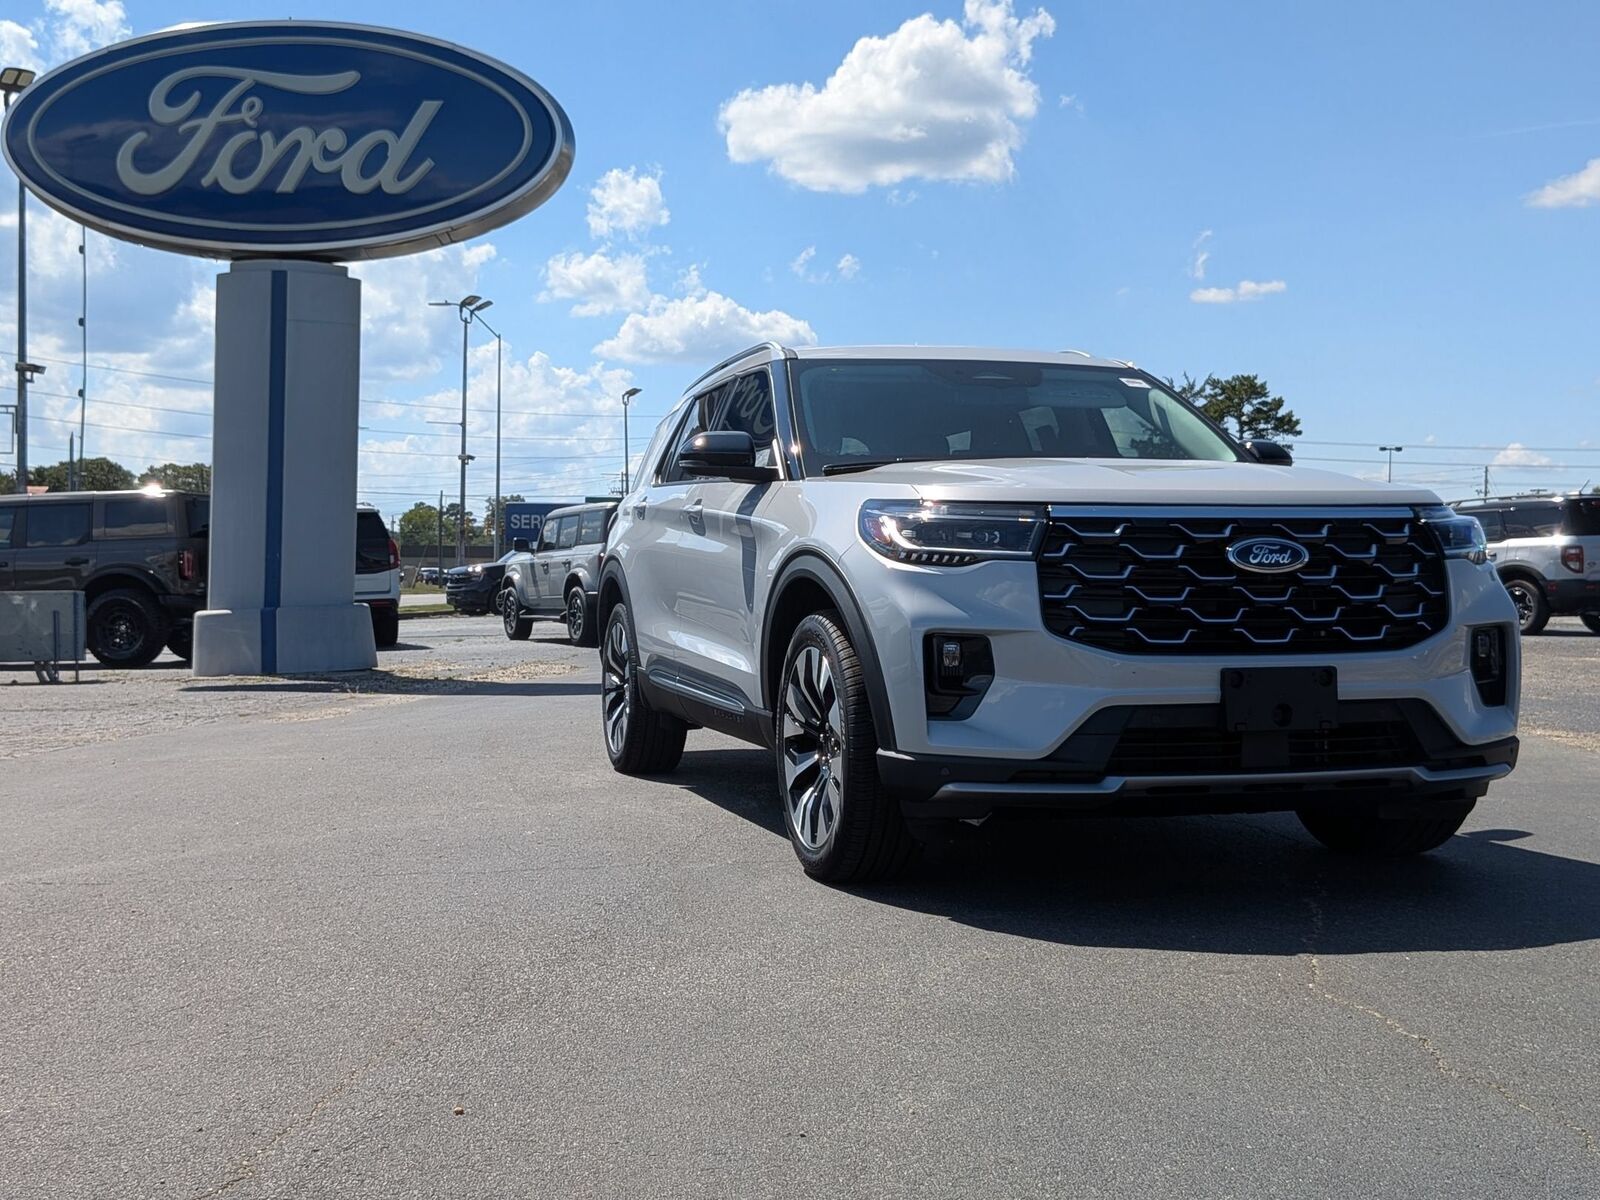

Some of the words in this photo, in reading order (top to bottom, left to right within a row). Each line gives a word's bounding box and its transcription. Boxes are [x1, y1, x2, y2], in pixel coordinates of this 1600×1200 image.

[117, 66, 443, 195] Ford
[510, 514, 546, 530] SER
[1249, 544, 1292, 564] Ford
